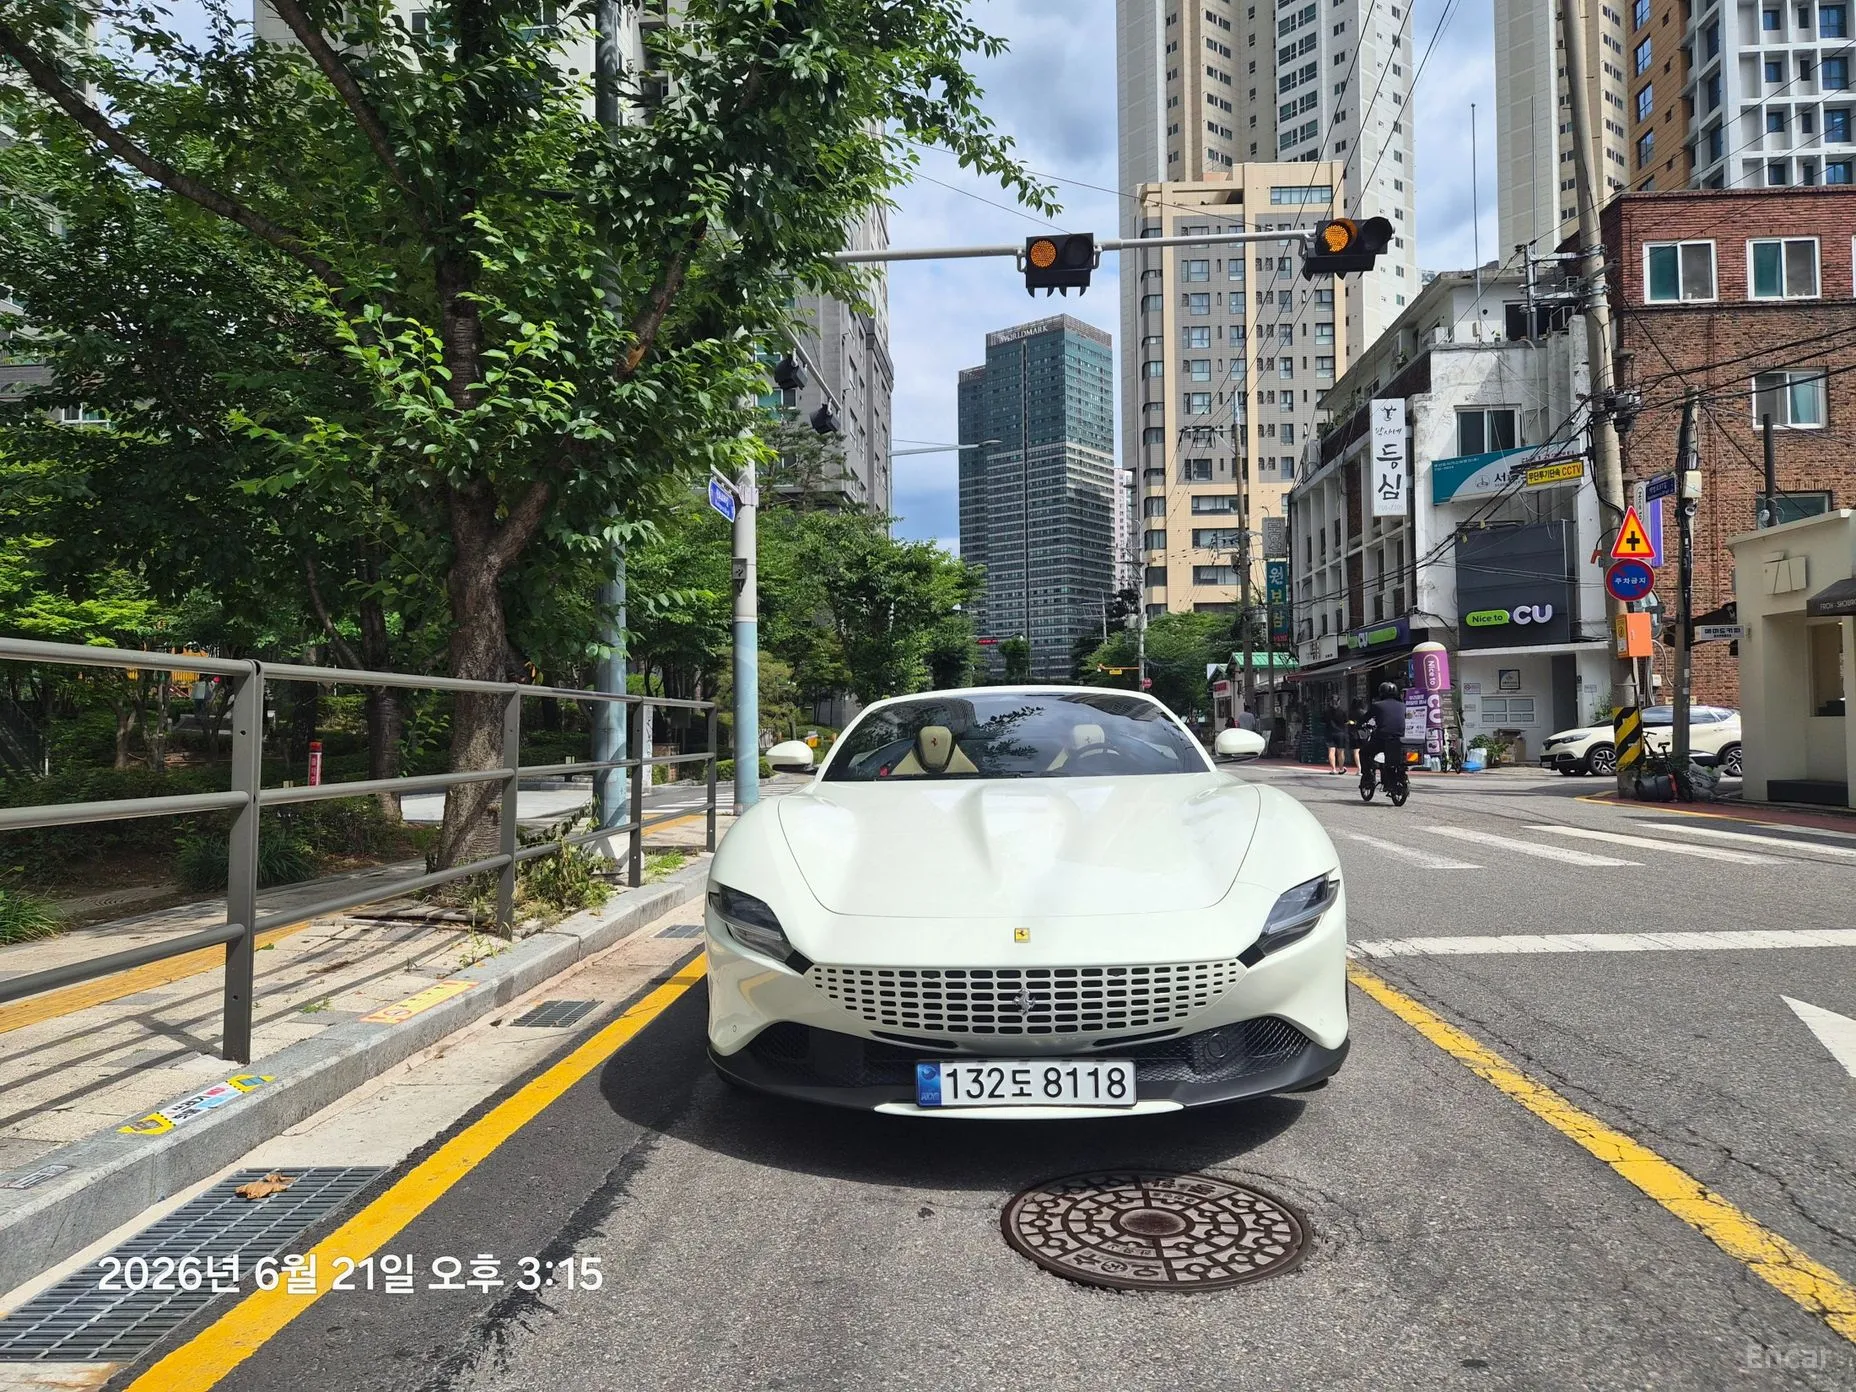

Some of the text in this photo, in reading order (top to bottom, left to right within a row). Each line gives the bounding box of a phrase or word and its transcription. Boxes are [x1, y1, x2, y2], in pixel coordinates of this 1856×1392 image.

[1000, 325, 1048, 343] WORLDMARK
[1376, 444, 1402, 500] 등심
[1561, 463, 1581, 477] CCTV
[1614, 576, 1646, 585] 주차금지
[1472, 614, 1492, 623] Nice
[1512, 604, 1553, 625] CU
[1427, 660, 1437, 686] Nice to
[1427, 694, 1442, 724] CU
[946, 1066, 1127, 1099] 132도 8118
